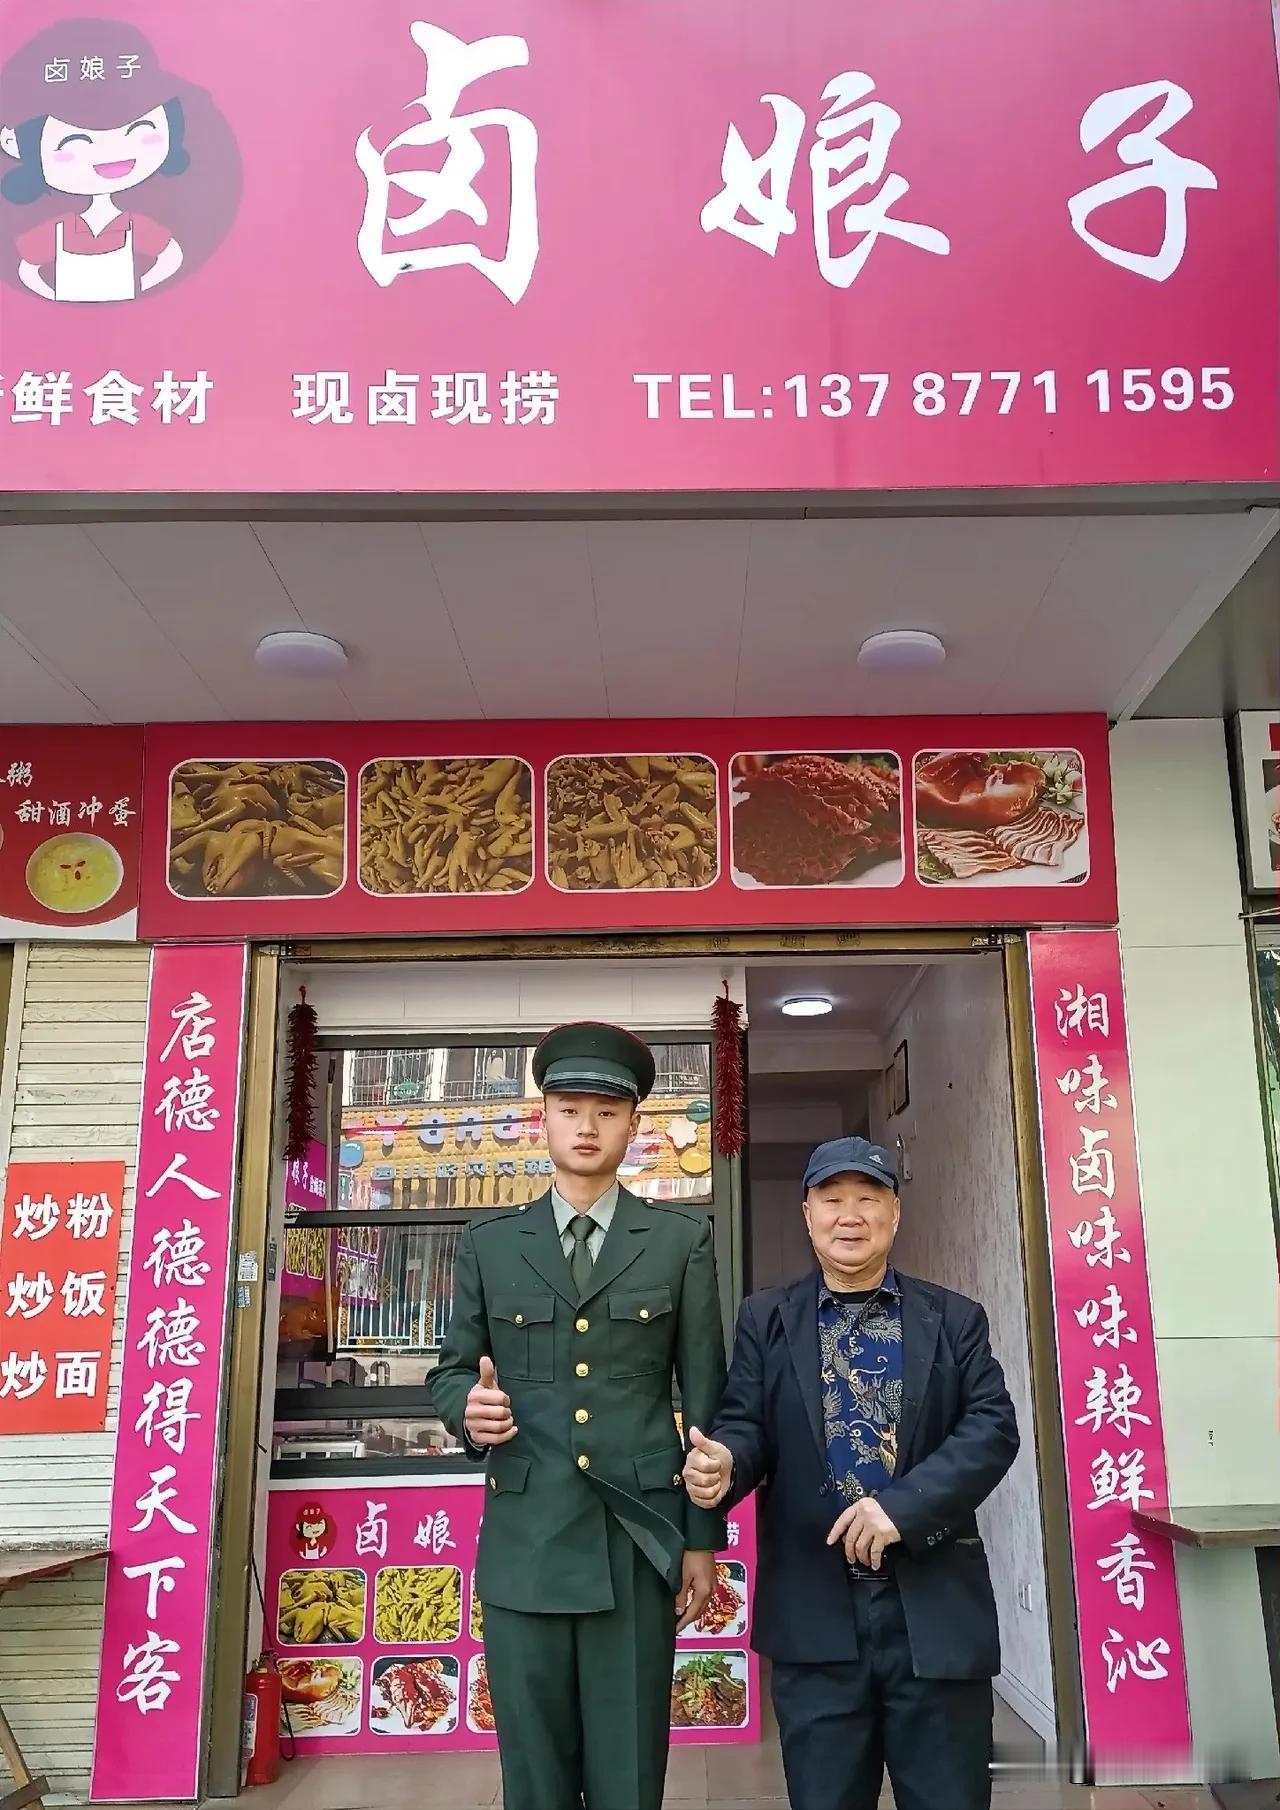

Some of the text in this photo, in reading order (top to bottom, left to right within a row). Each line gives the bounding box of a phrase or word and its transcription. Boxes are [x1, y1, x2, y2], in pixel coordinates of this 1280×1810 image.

[44, 53, 142, 83] 卤娘子
[354, 20, 1219, 305] 卤娘子
[0, 369, 559, 426] 鲜食材 现卤现捞
[0, 761, 33, 787] 粥
[14, 795, 136, 828] 甜酒冲蛋
[12, 1192, 114, 1240] 炒粉
[5, 1270, 108, 1320] 炒饭
[0, 1350, 102, 1399] 炒面
[116, 992, 222, 1715] 店德人德德得天下客
[354, 1501, 484, 1559] 卤娘
